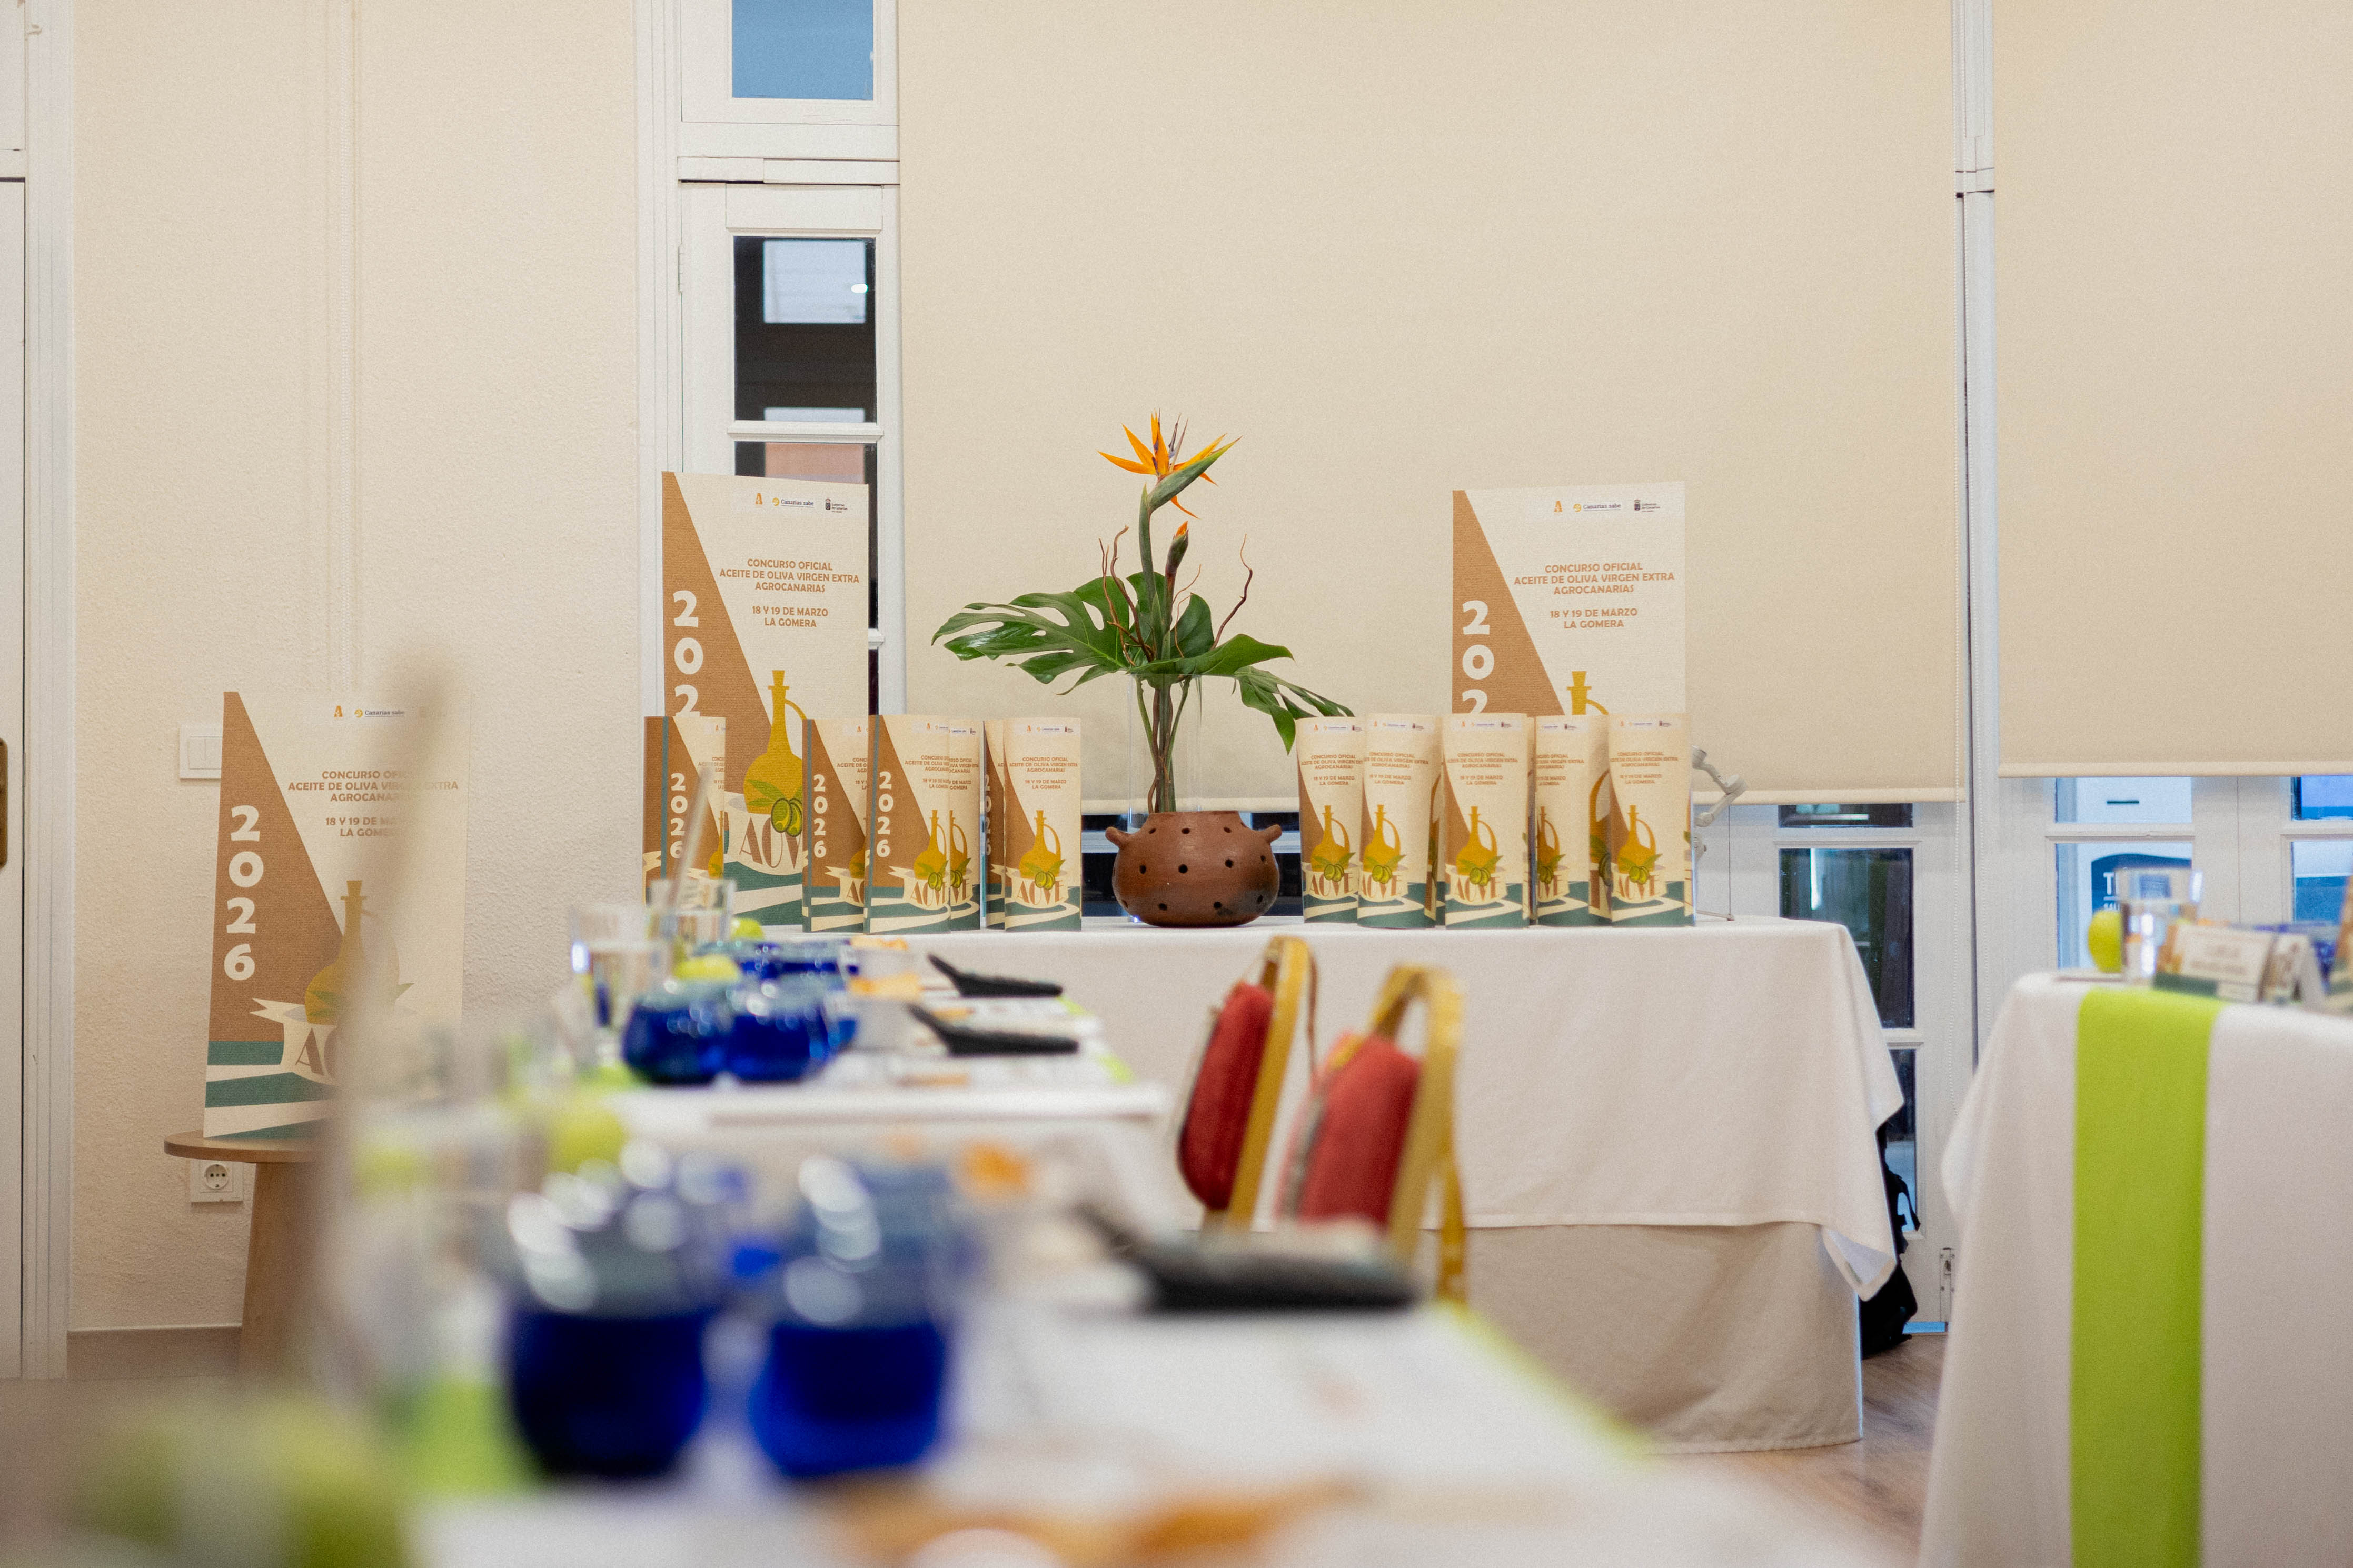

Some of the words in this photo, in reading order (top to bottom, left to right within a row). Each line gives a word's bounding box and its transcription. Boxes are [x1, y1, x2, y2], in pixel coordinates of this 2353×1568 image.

[755, 493, 763, 505] A
[747, 558, 796, 569] CONCURSO
[798, 561, 833, 571] OFICIAL
[1545, 563, 1600, 573] CONCURSO
[1603, 562, 1643, 571] OFICIAL
[720, 568, 750, 578] ACEITE
[767, 571, 795, 580] OLIVA
[797, 572, 830, 582] VIRGEN
[832, 574, 859, 583] EXTRA
[1514, 576, 1548, 585] ACEITE
[1567, 575, 1598, 583] OLIVA
[1601, 574, 1639, 582] VIRGEN
[1642, 572, 1675, 581] EXTRA
[755, 582, 825, 593] AGROCANARIAS
[1554, 585, 1634, 595] AGROCANARIAS
[752, 606, 761, 614] 18
[771, 606, 780, 615] 19
[783, 607, 795, 615] DE
[797, 608, 828, 616] MARZO
[1571, 609, 1582, 617] 19
[1601, 608, 1638, 616] MARZO
[765, 617, 776, 626] LA
[778, 618, 817, 627] GOMERA
[1580, 620, 1624, 628] GOMERA
[673, 590, 703, 717] 202
[1462, 600, 1494, 716] 202
[322, 771, 380, 779] CONCURSO
[813, 774, 828, 858] 2026
[877, 771, 893, 857] 2026
[224, 805, 264, 981] 2026
